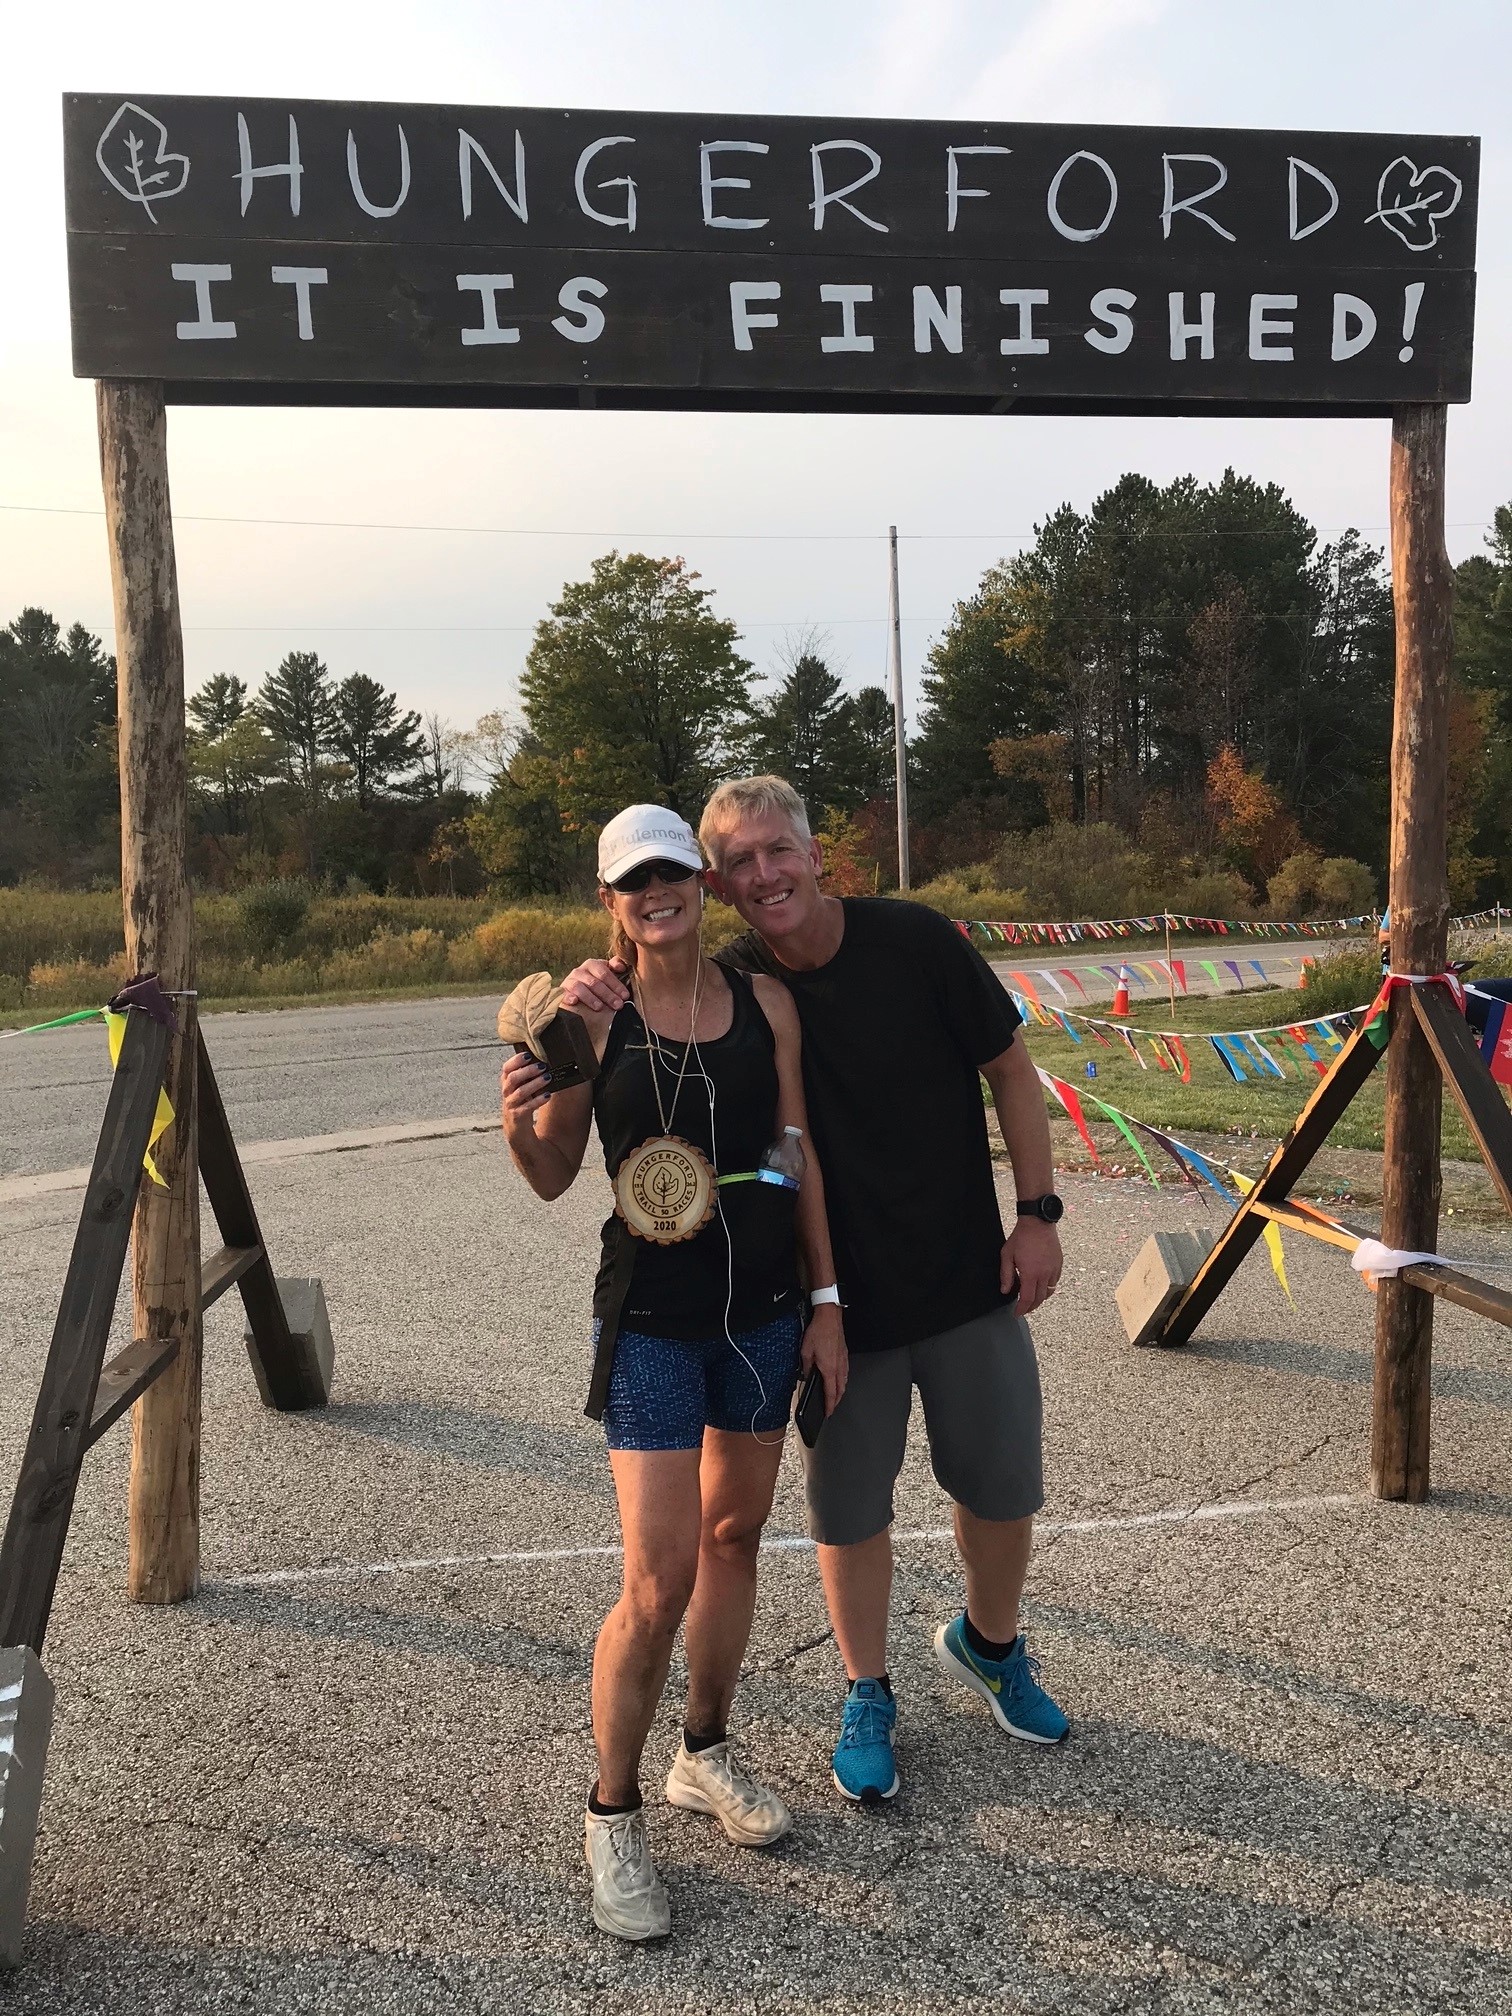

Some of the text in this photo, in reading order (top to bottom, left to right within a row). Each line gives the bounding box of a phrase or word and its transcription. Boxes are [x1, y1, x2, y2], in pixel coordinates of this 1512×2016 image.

[232, 112, 1340, 242] HUNGERFORD
[171, 263, 1425, 363] IT IS FINISHED!
[636, 1153, 693, 1179] HUNGERFORD
[636, 1191, 656, 1214] TRAIL
[673, 1190, 693, 1213] RACES
[653, 1220, 676, 1231] 2020
